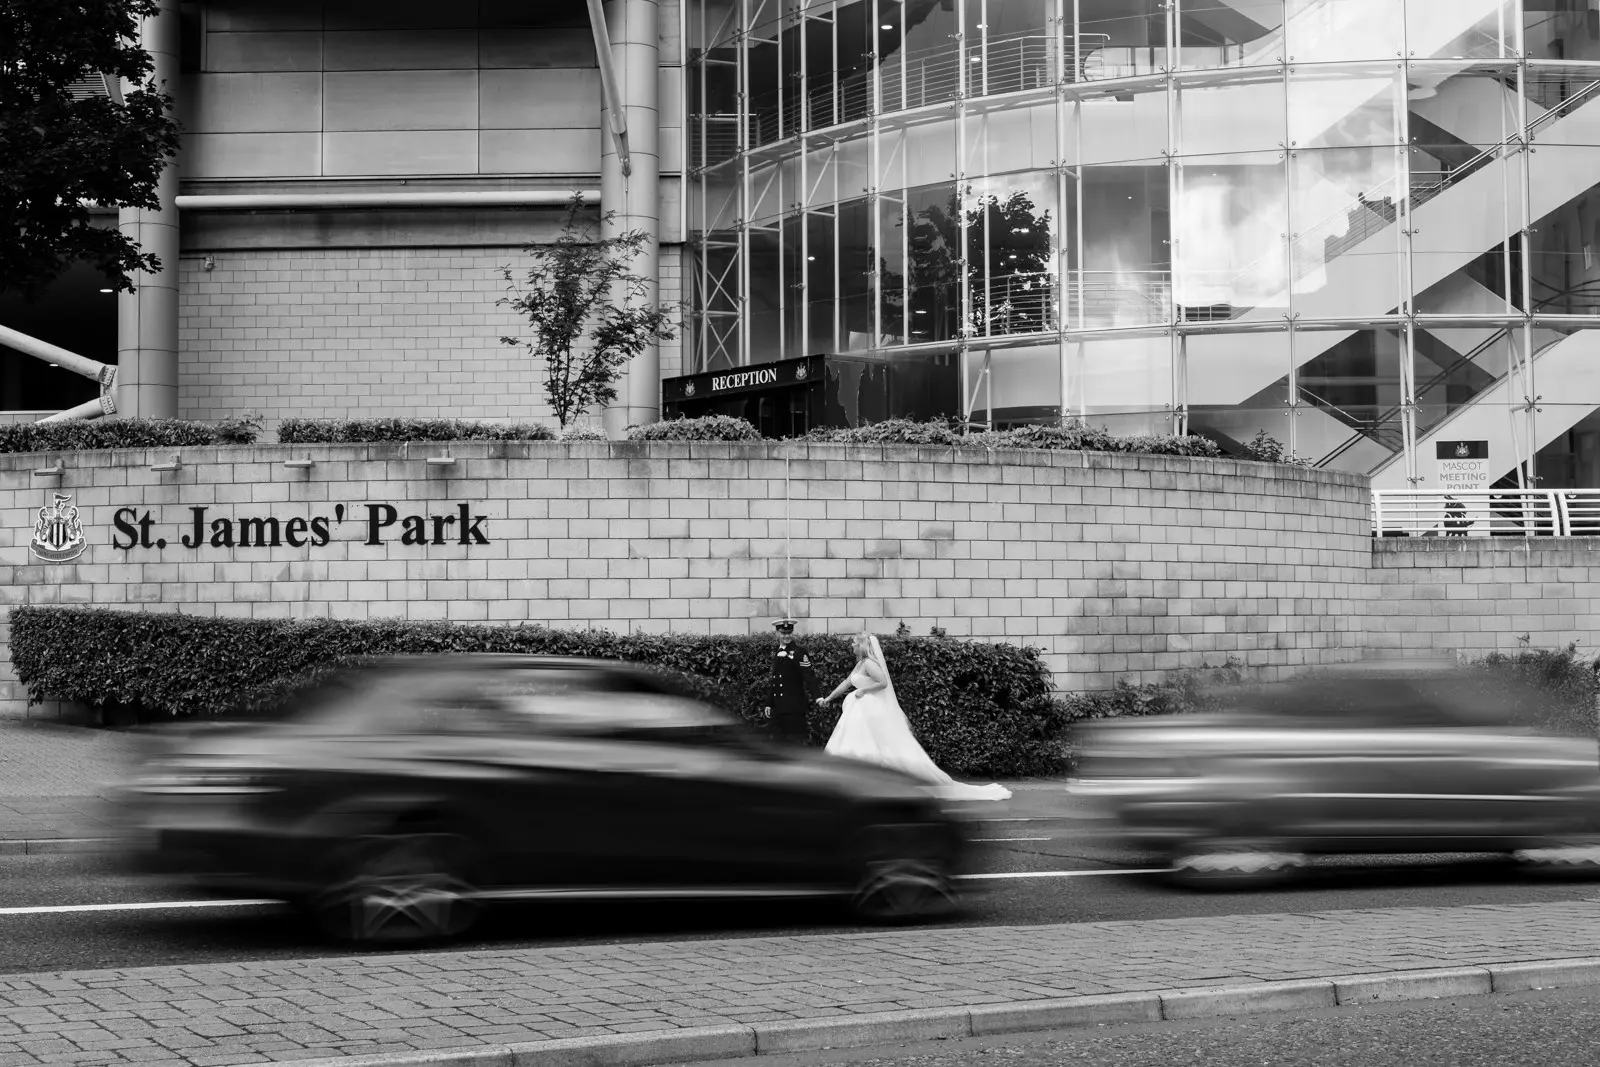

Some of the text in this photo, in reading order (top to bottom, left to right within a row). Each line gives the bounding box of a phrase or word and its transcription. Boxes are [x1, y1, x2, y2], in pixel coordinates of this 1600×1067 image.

[712, 368, 777, 391] RECEPTION
[1442, 462, 1483, 471] MASCOT
[1439, 473, 1487, 481] MEETING
[112, 503, 491, 550] St. James' Park
